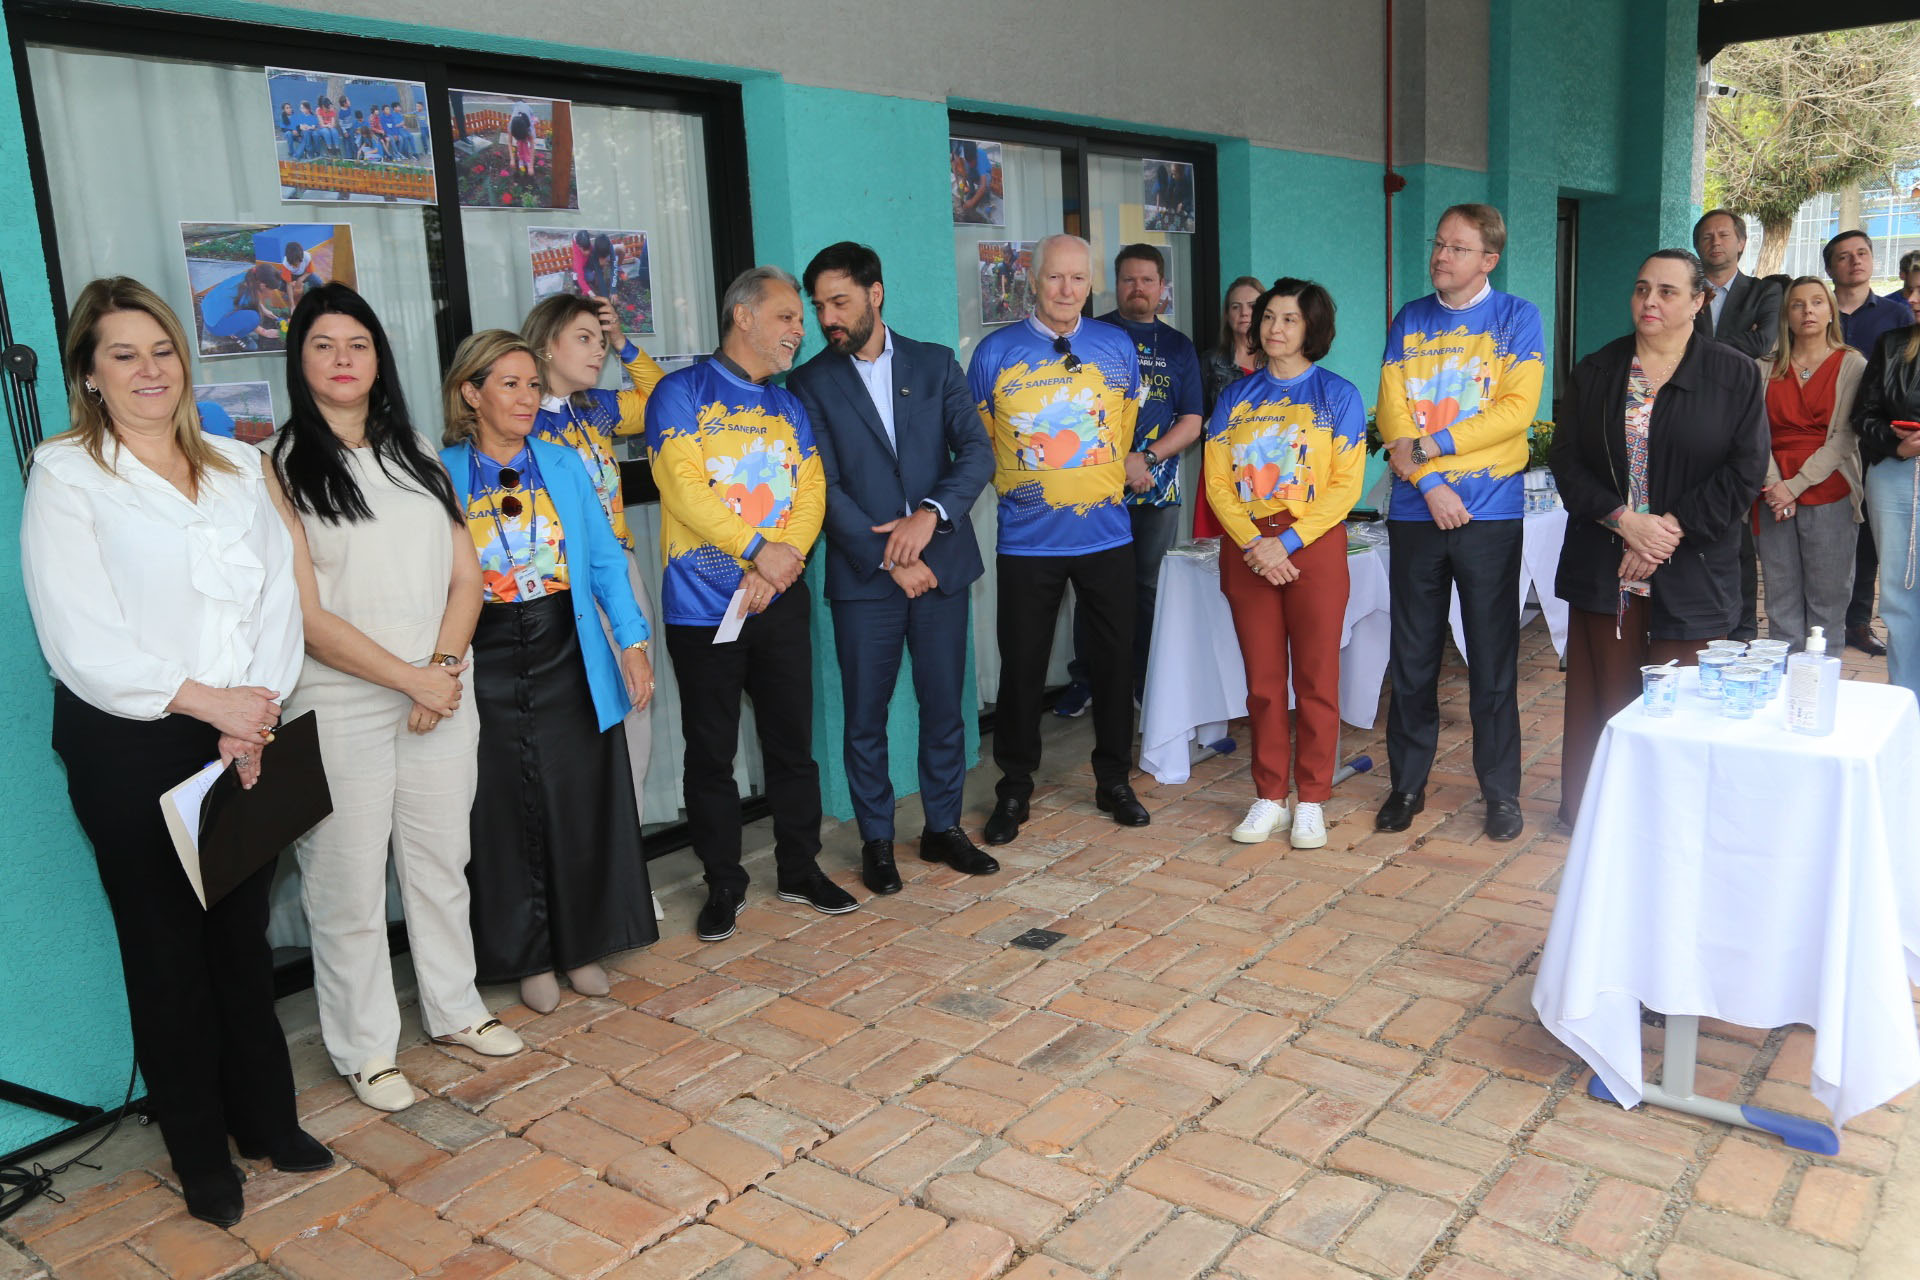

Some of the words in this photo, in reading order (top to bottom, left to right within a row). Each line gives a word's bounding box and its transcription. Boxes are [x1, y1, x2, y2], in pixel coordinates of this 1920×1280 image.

[1420, 346, 1465, 357] SANEPAR
[1025, 376, 1073, 389] SANEPAR
[1245, 415, 1286, 424] SANEPAR
[727, 423, 767, 435] SANEPAR
